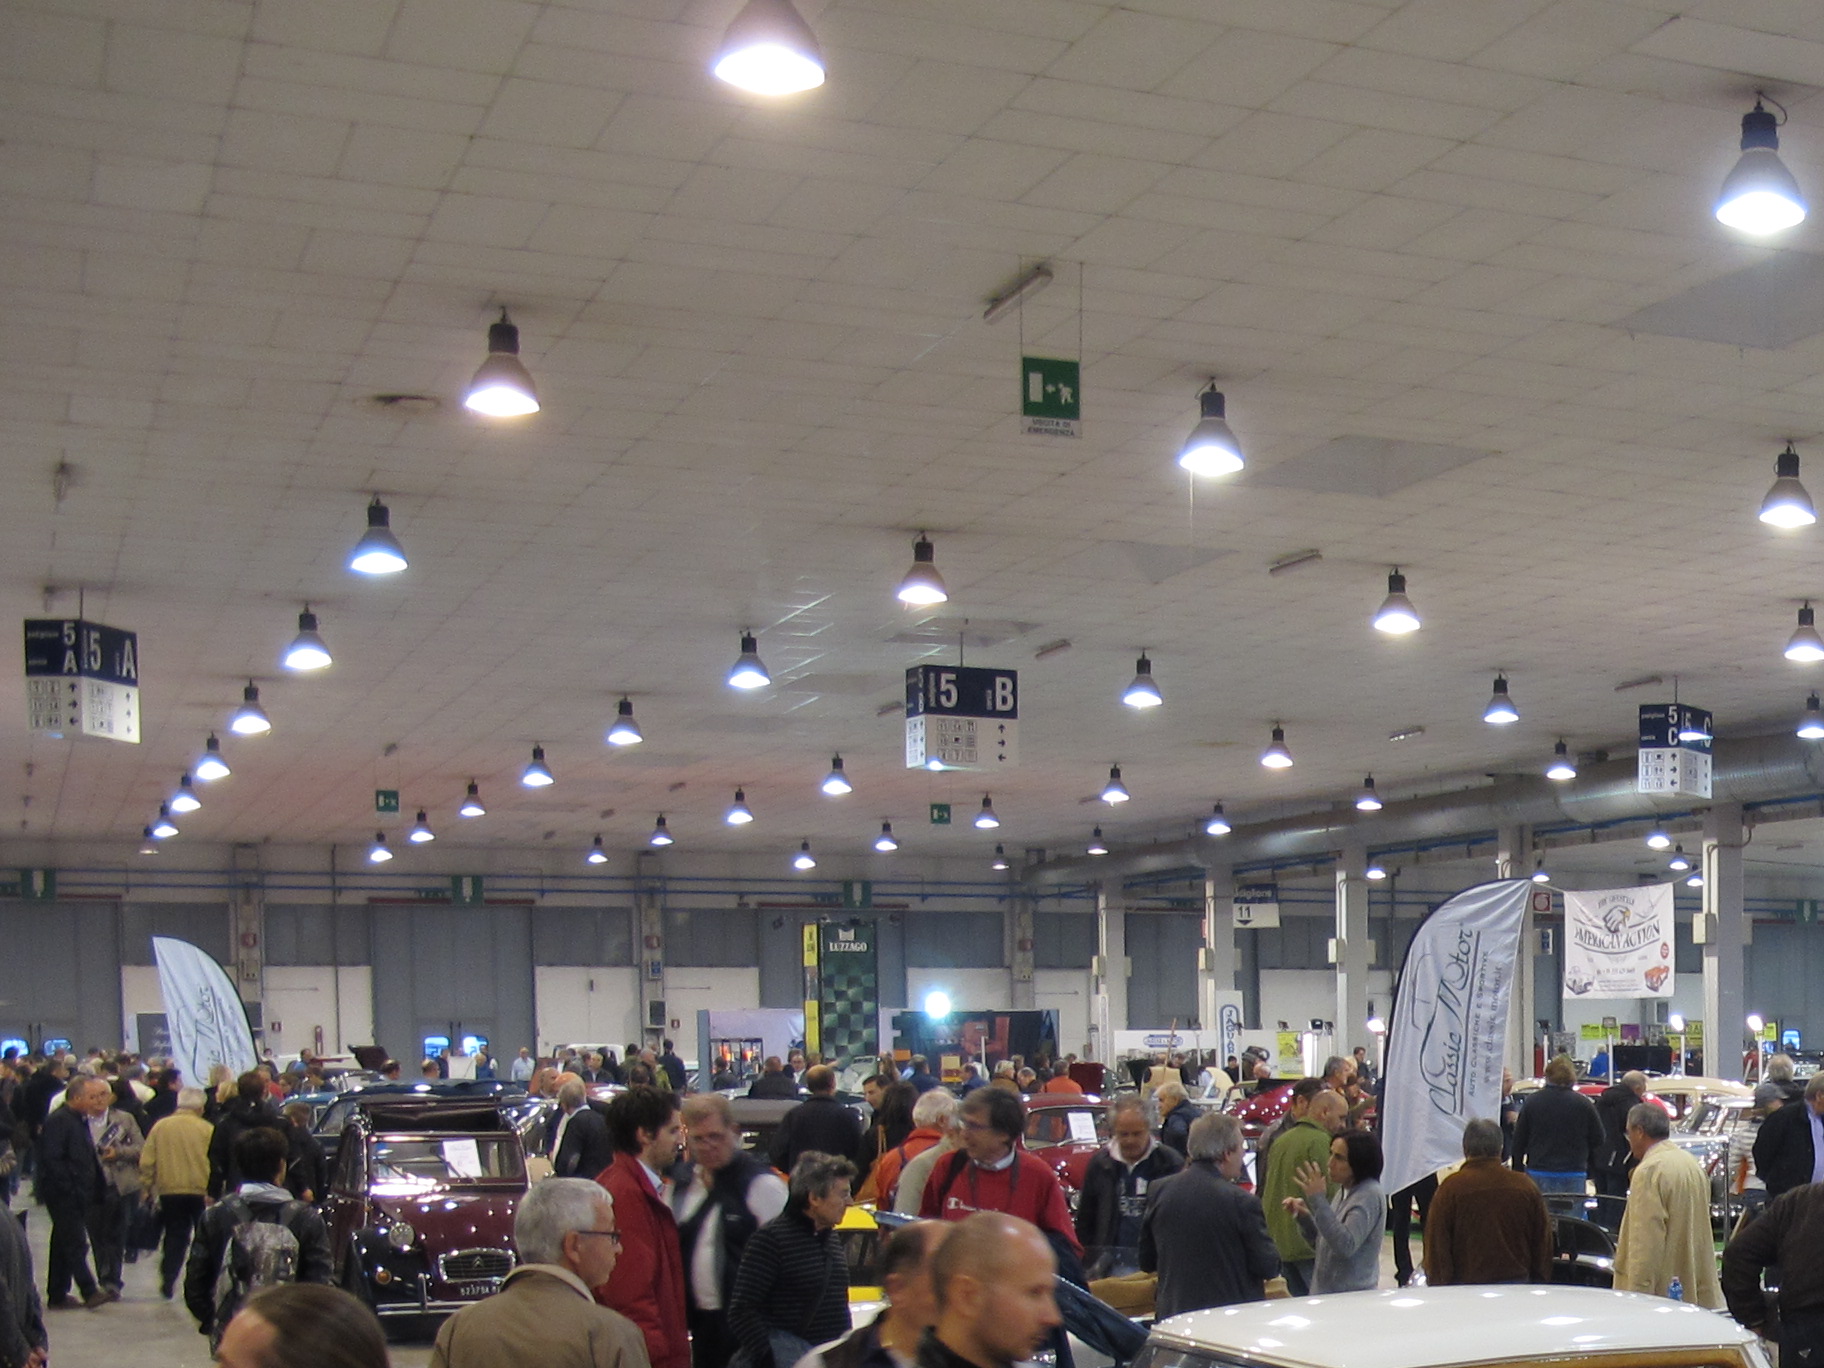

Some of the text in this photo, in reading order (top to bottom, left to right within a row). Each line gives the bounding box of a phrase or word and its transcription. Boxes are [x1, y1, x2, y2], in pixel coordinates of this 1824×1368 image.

[63, 622, 76, 647] 5
[63, 650, 79, 674] A
[89, 631, 137, 679] 5 A
[940, 672, 959, 708] 5
[995, 676, 1015, 712] B
[1668, 705, 1678, 725] 5
[1667, 727, 1678, 746] C
[1239, 905, 1251, 919] 11
[829, 941, 868, 953] LUZZAGO
[1419, 1030, 1462, 1116] Classic
